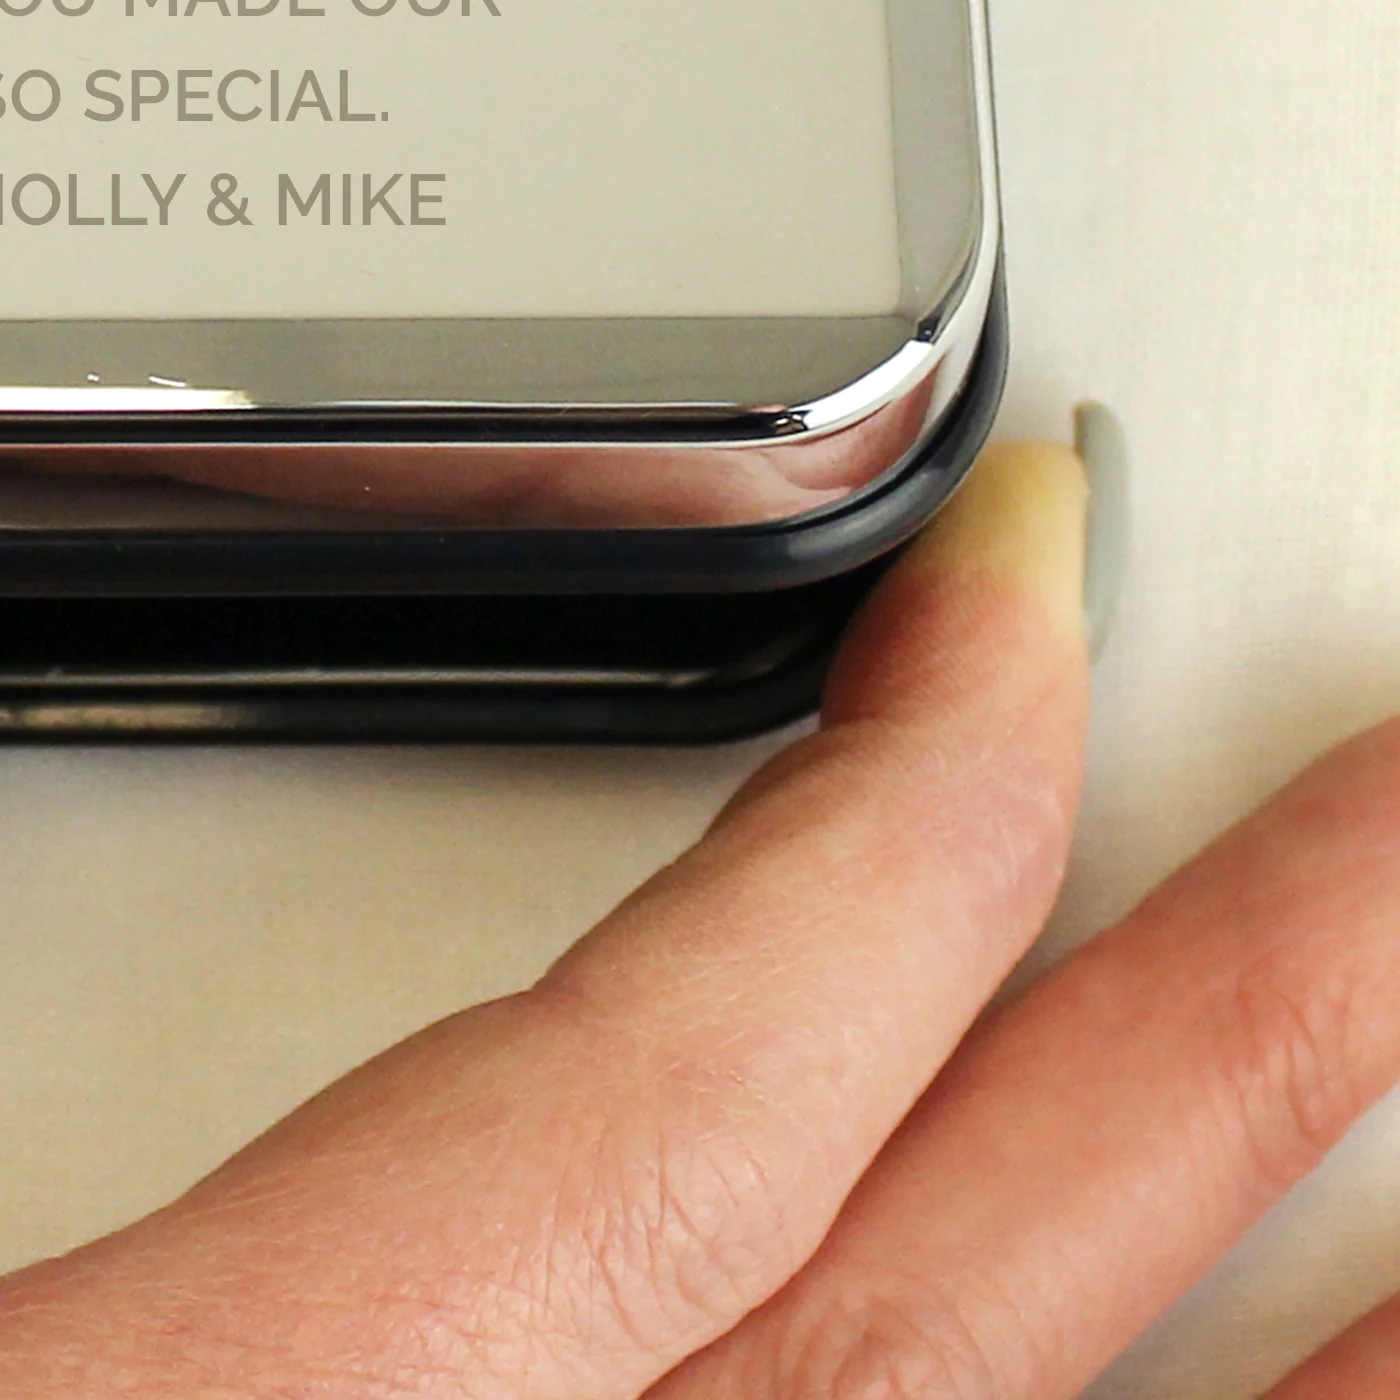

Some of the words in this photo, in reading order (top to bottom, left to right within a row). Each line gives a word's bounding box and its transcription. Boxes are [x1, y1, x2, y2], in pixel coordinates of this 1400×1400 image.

[83, 69, 389, 122] SPECIAL.
[206, 172, 255, 227] &
[278, 173, 447, 226] MIKE
